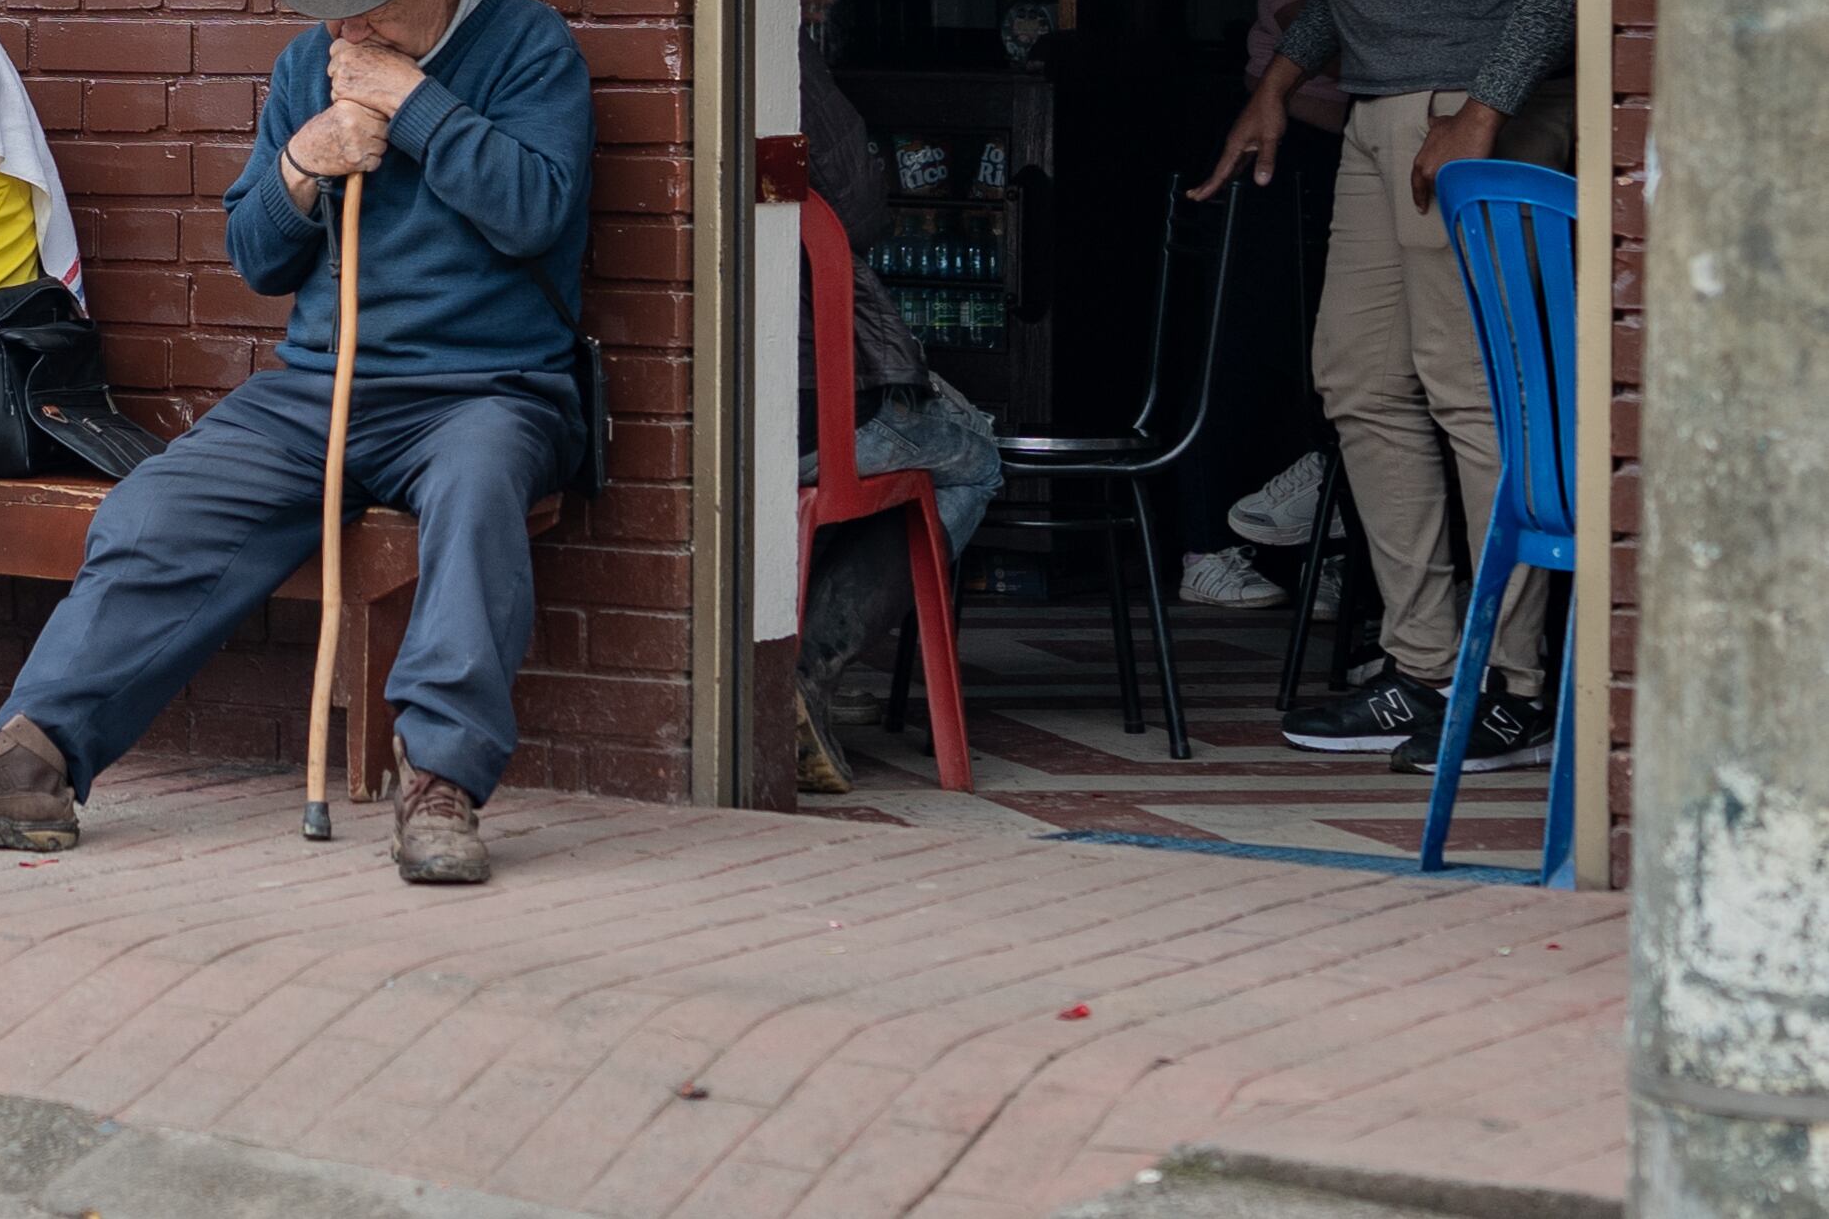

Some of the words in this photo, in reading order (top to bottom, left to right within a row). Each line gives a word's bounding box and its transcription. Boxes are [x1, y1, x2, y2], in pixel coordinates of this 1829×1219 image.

[898, 164, 948, 189] Rico
[1367, 687, 1415, 731] N
[1482, 705, 1524, 745] N
